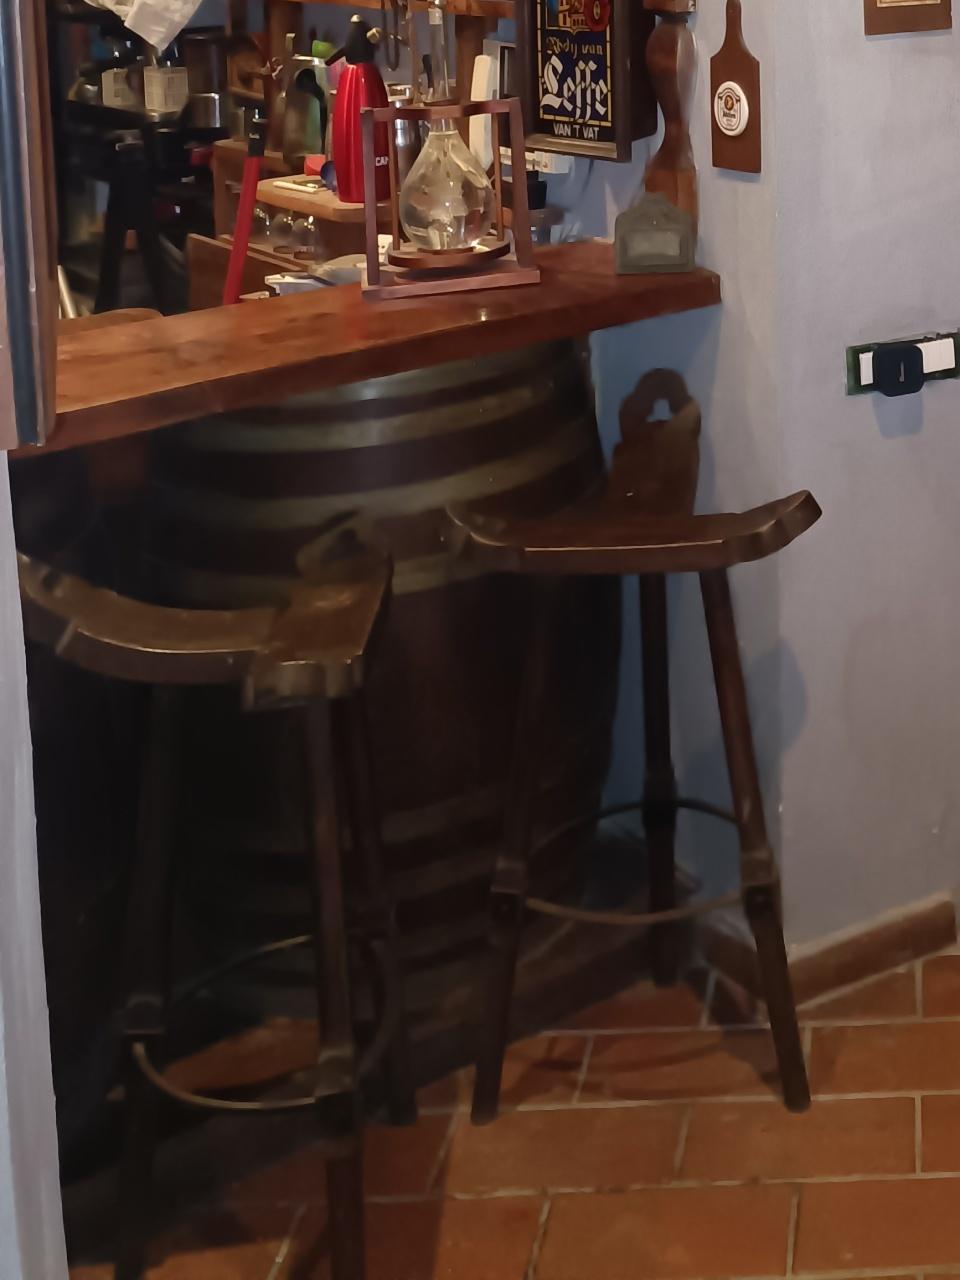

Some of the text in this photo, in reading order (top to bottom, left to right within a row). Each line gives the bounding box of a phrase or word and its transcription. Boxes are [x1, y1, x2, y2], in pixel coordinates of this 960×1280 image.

[582, 43, 604, 56] van
[540, 55, 608, 122] Leffe
[553, 122, 572, 137] VAN
[583, 125, 600, 141] VAT
